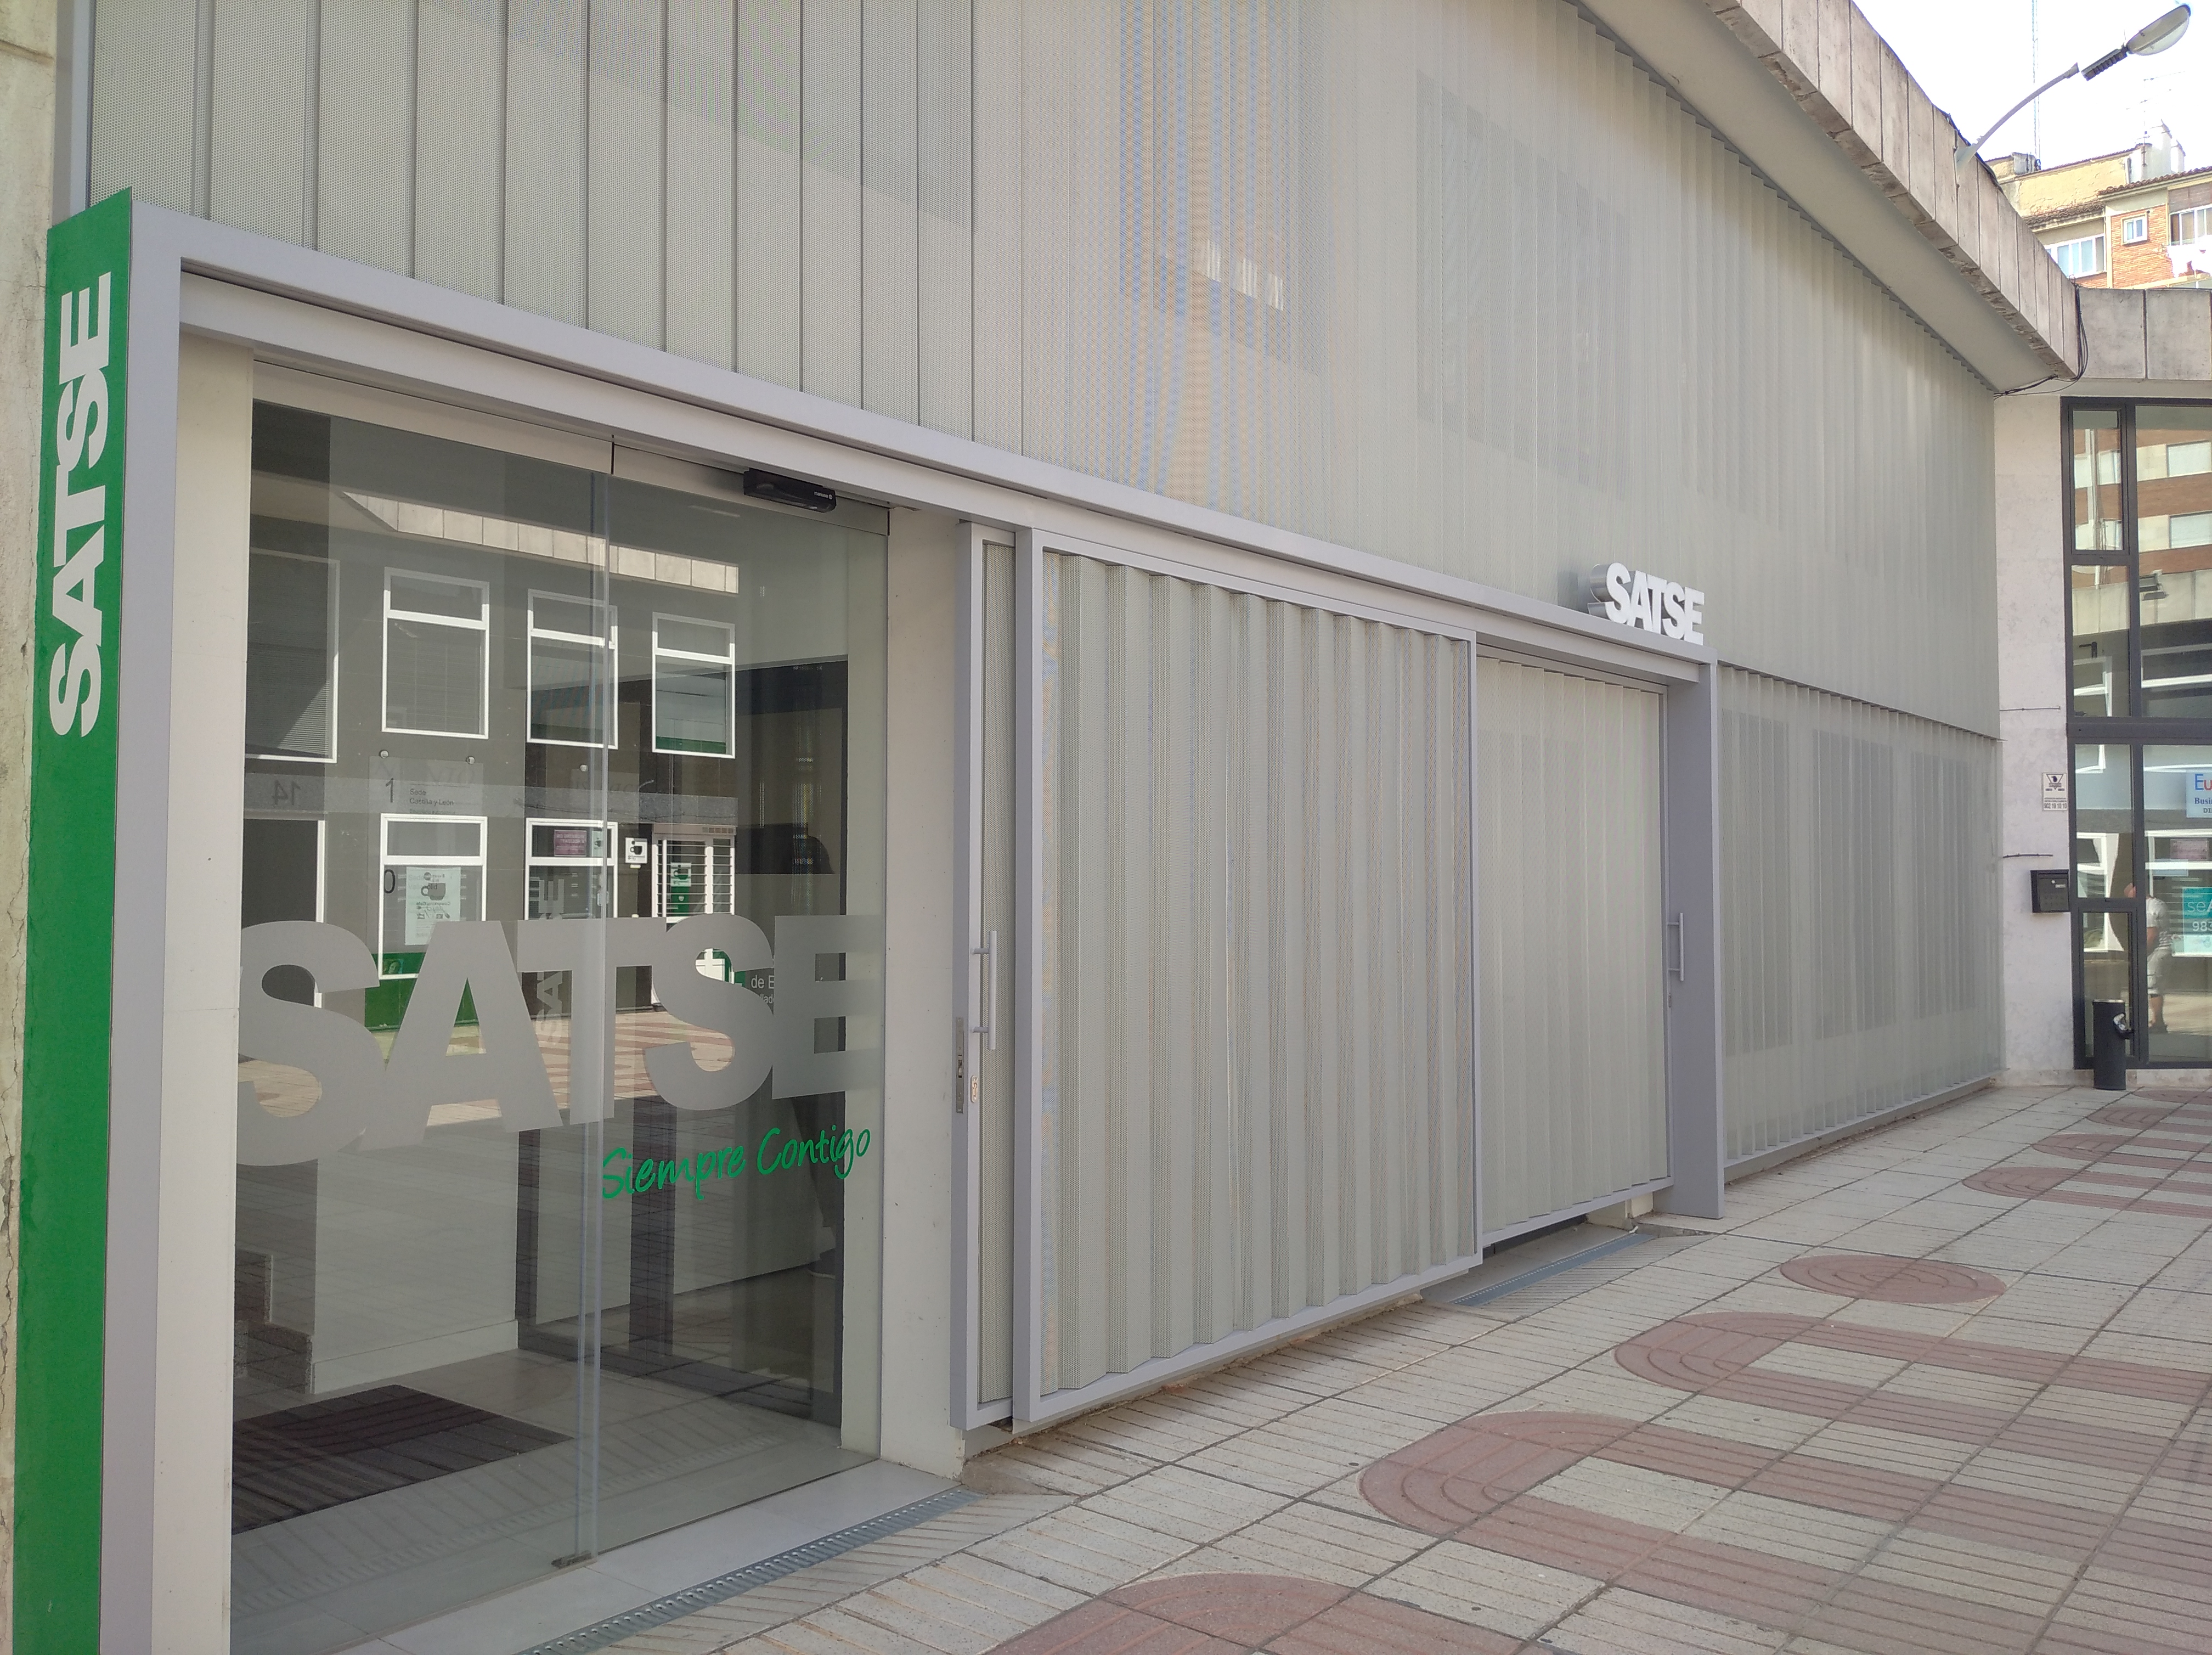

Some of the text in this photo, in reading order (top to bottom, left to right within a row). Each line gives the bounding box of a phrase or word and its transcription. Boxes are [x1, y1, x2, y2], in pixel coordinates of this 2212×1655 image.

[49, 271, 111, 737] SATSE
[1603, 562, 1705, 646] SATSE
[385, 778, 393, 803] 1
[2194, 773, 2212, 791] Eu
[751, 975, 765, 989] de
[238, 913, 879, 1167] SATSE
[603, 1124, 871, 1200] Siempre Contigo
